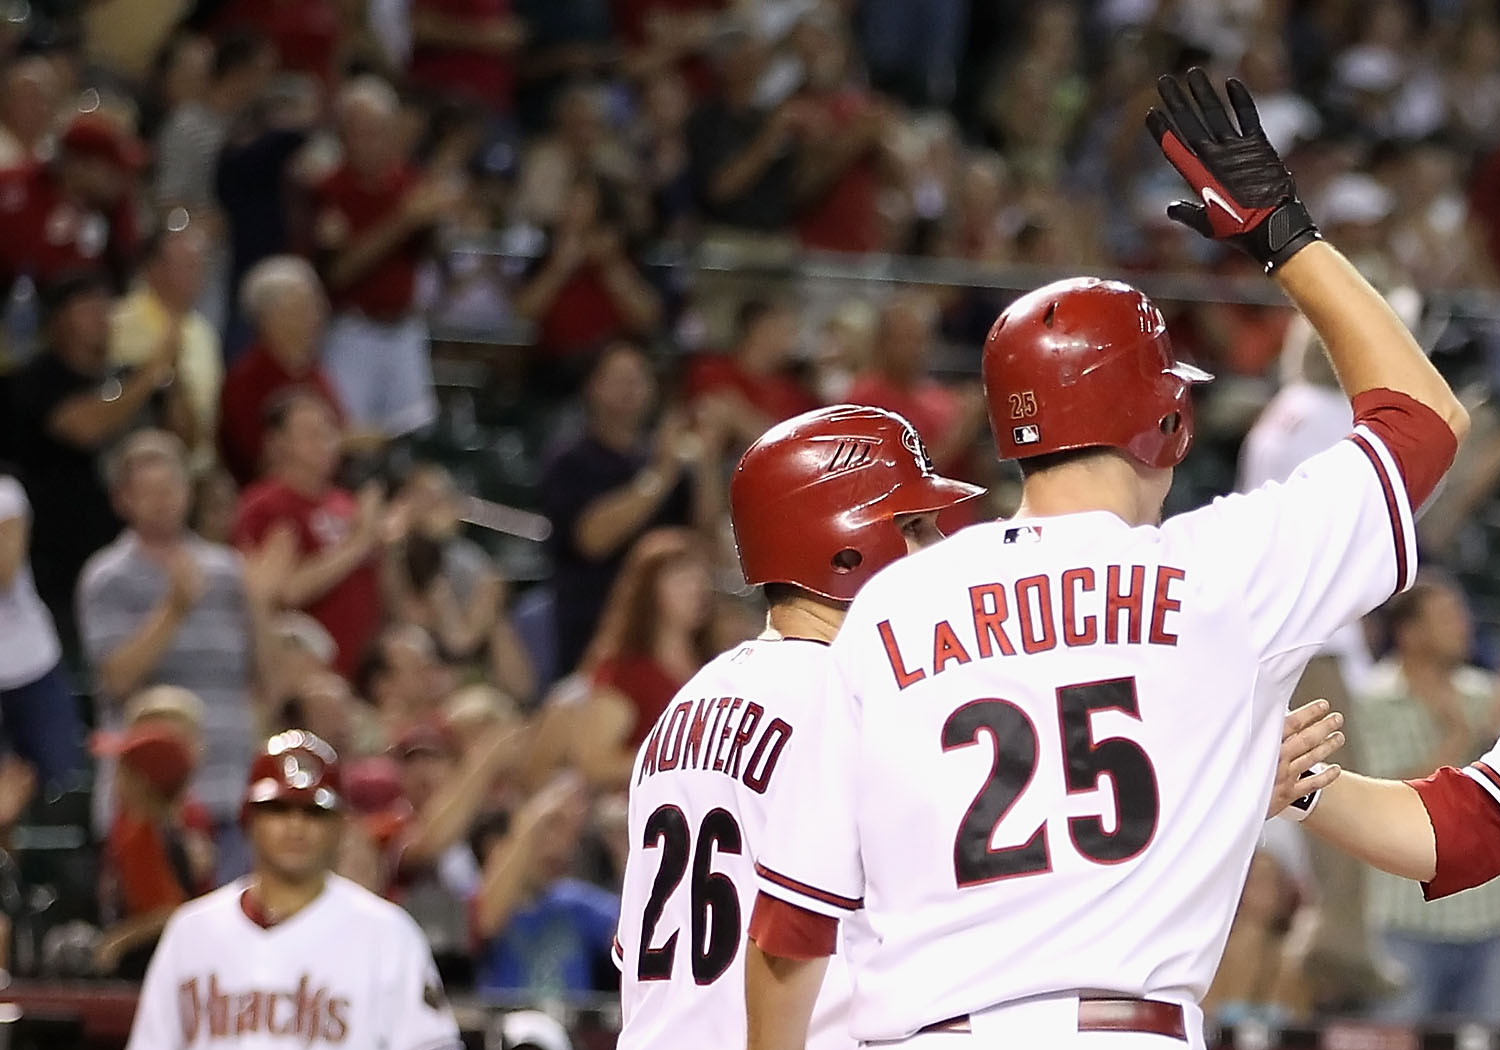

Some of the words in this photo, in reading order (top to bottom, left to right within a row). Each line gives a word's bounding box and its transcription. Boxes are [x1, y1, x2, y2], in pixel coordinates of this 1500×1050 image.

[1008, 391, 1038, 419] 25
[637, 697, 793, 794] MONTERO
[940, 675, 1160, 889] 25
[637, 803, 742, 986] 26
